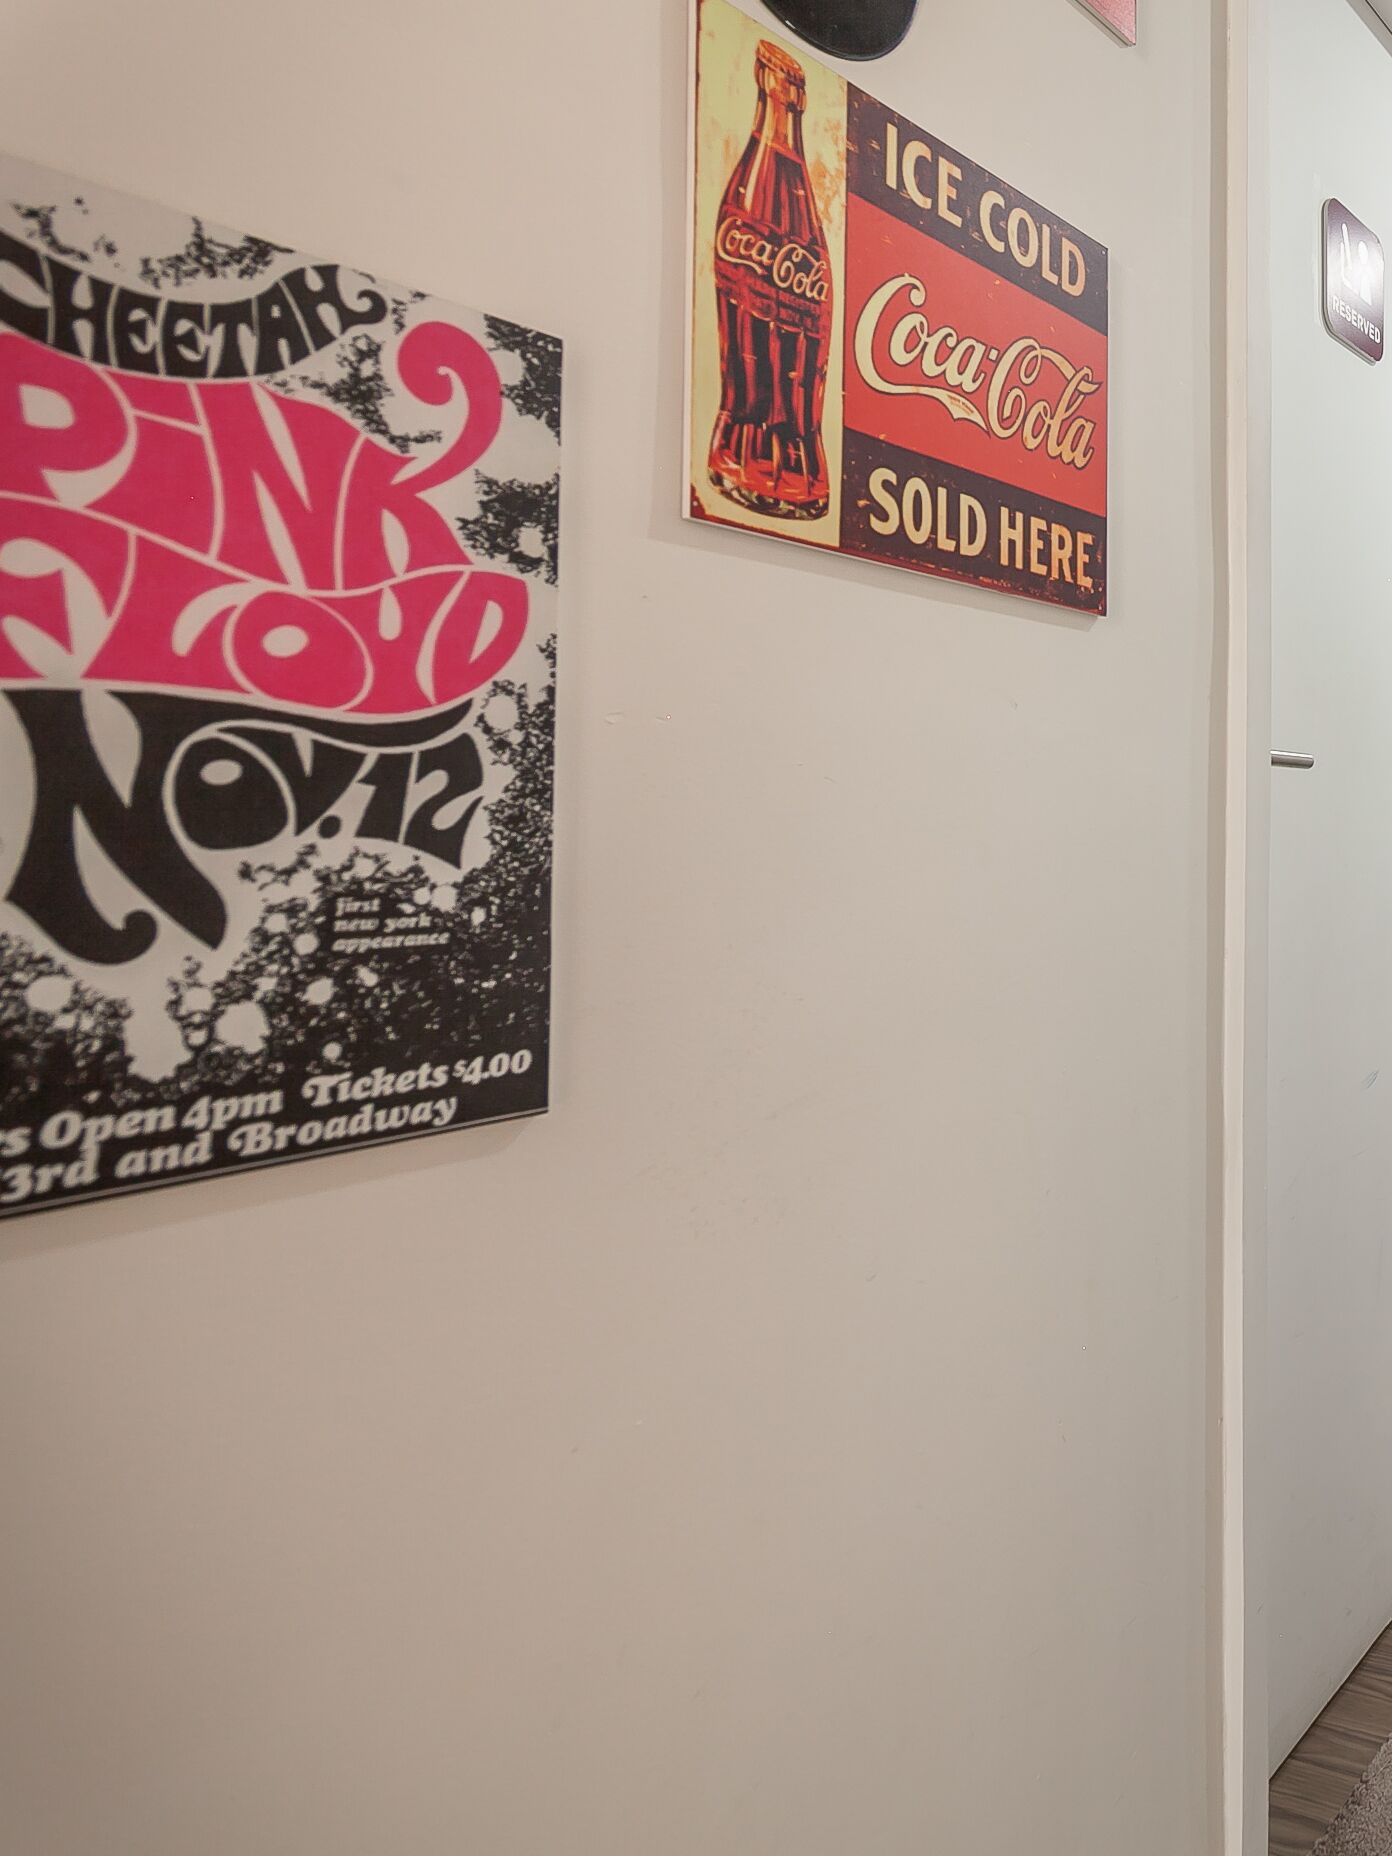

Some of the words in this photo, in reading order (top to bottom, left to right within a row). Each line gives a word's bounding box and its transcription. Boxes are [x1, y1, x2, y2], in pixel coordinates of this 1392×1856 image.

[885, 122, 964, 228] ICE
[979, 190, 1087, 297] COLD
[1331, 296, 1382, 344] RESERVED
[0, 321, 503, 591] PINK
[868, 467, 988, 557] SOLD
[1000, 506, 1094, 589] HERE
[331, 932, 450, 953] appearance
[333, 918, 380, 932] new
[383, 912, 432, 933] york
[335, 897, 380, 917] first
[39, 1105, 178, 1152] Open
[181, 1089, 284, 1131] 4pm
[302, 1062, 449, 1107] Tickets
[452, 1049, 532, 1085] $4.00
[114, 1131, 213, 1179] and
[227, 1097, 458, 1158] Broadway
